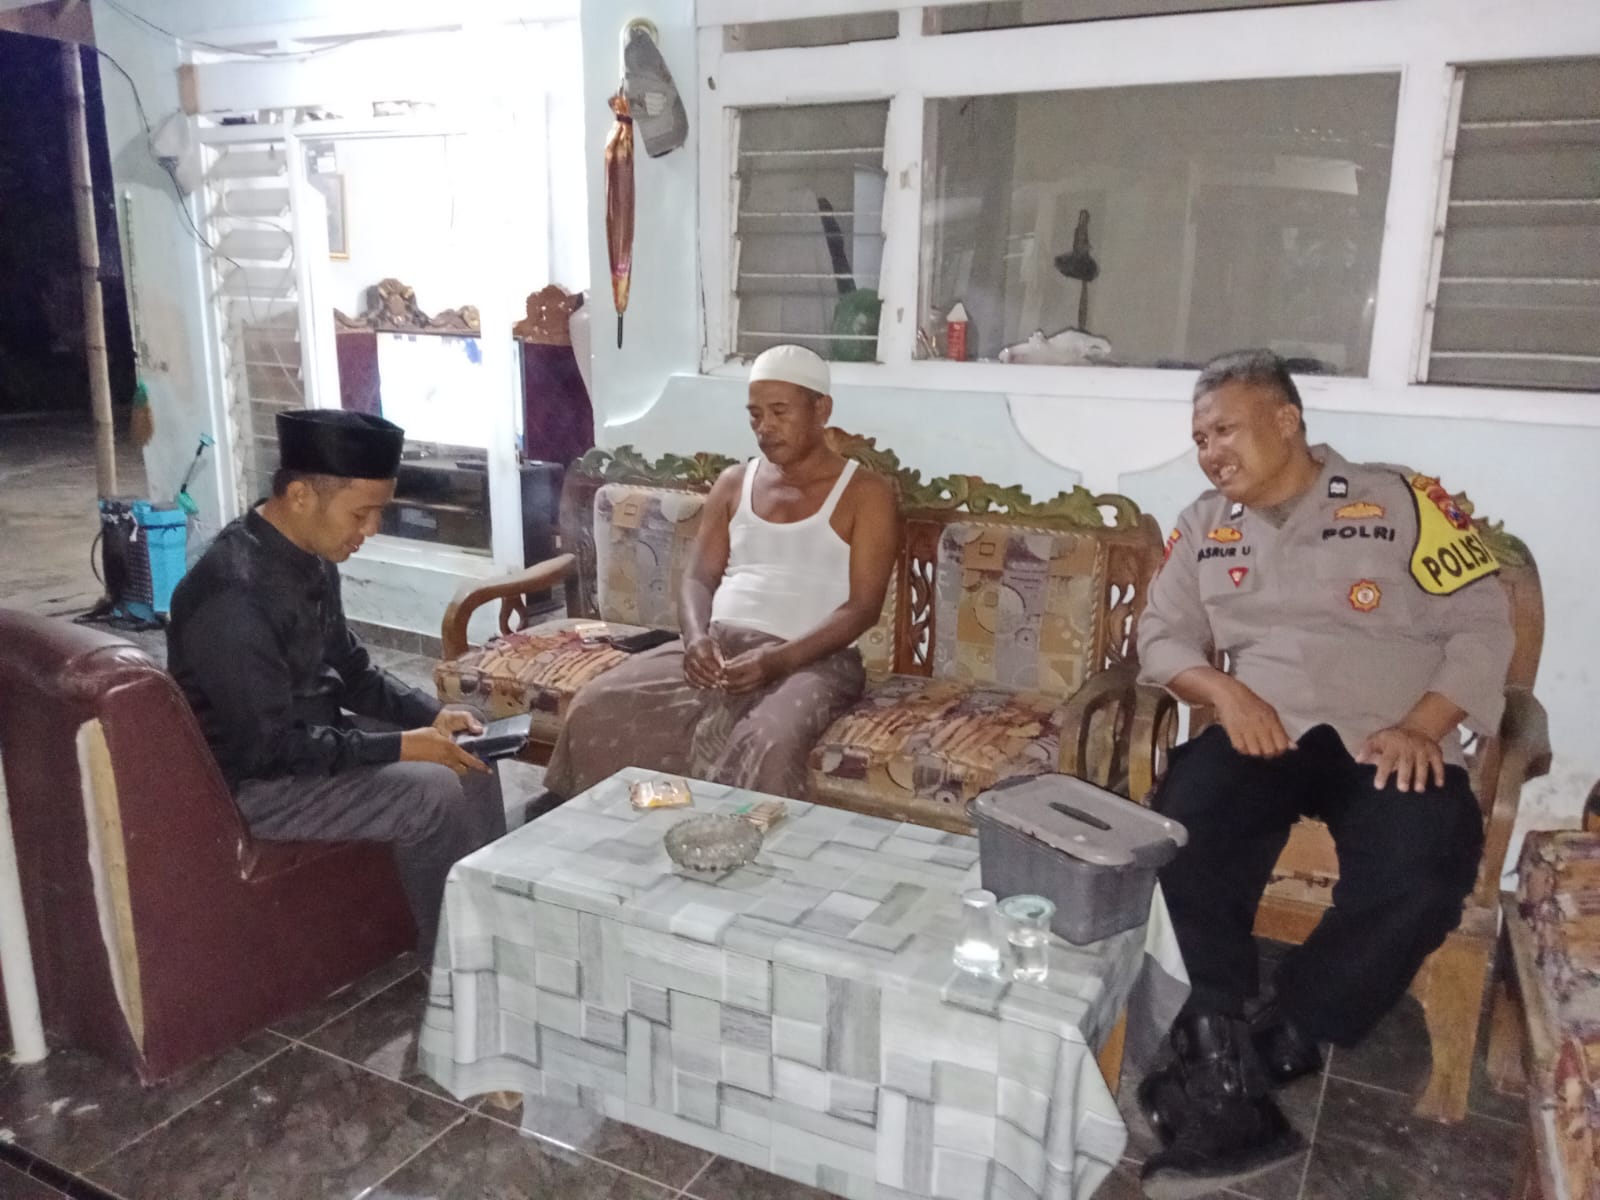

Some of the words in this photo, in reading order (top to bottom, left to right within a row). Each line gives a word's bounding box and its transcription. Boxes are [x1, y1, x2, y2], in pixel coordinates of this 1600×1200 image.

[1322, 525, 1395, 542] POLRI
[1242, 545, 1251, 556] U
[1422, 534, 1493, 587] POLISI
